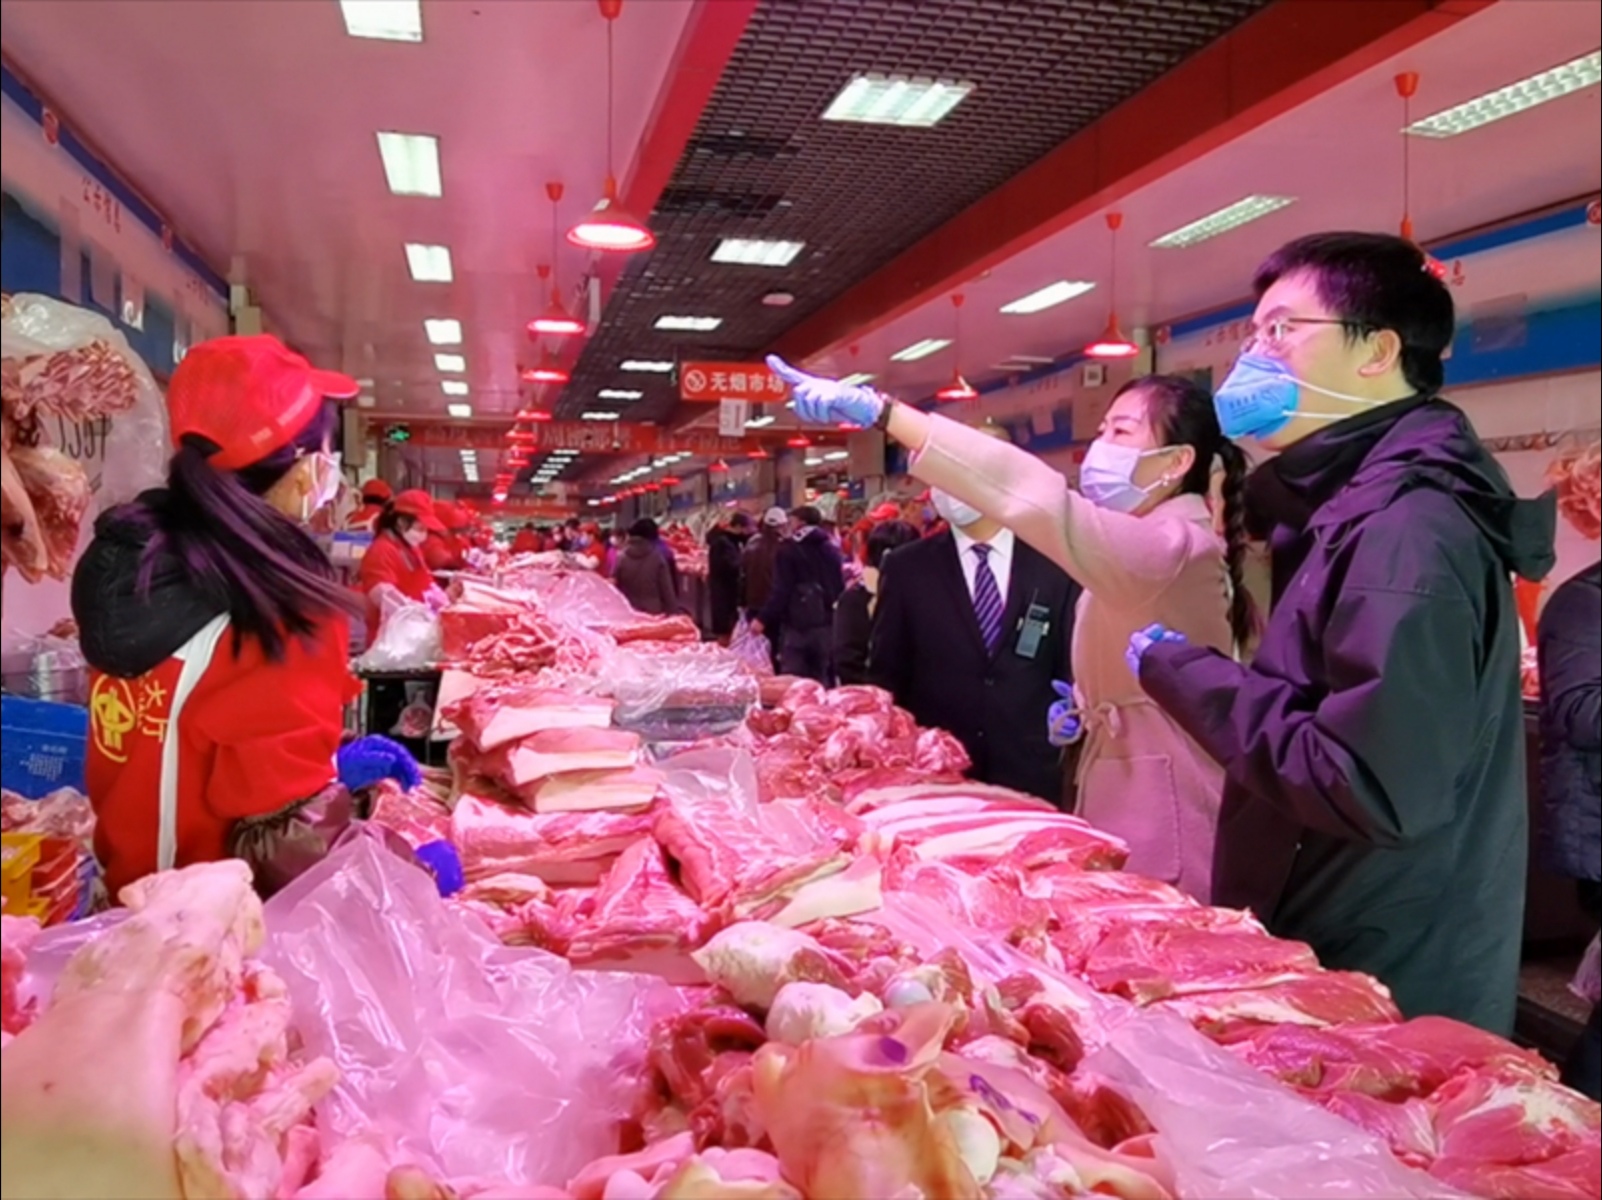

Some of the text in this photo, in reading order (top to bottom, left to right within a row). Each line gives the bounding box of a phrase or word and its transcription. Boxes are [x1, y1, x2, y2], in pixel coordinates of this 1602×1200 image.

[710, 372, 784, 393] 无烟市场
[143, 669, 170, 743] 大厅
